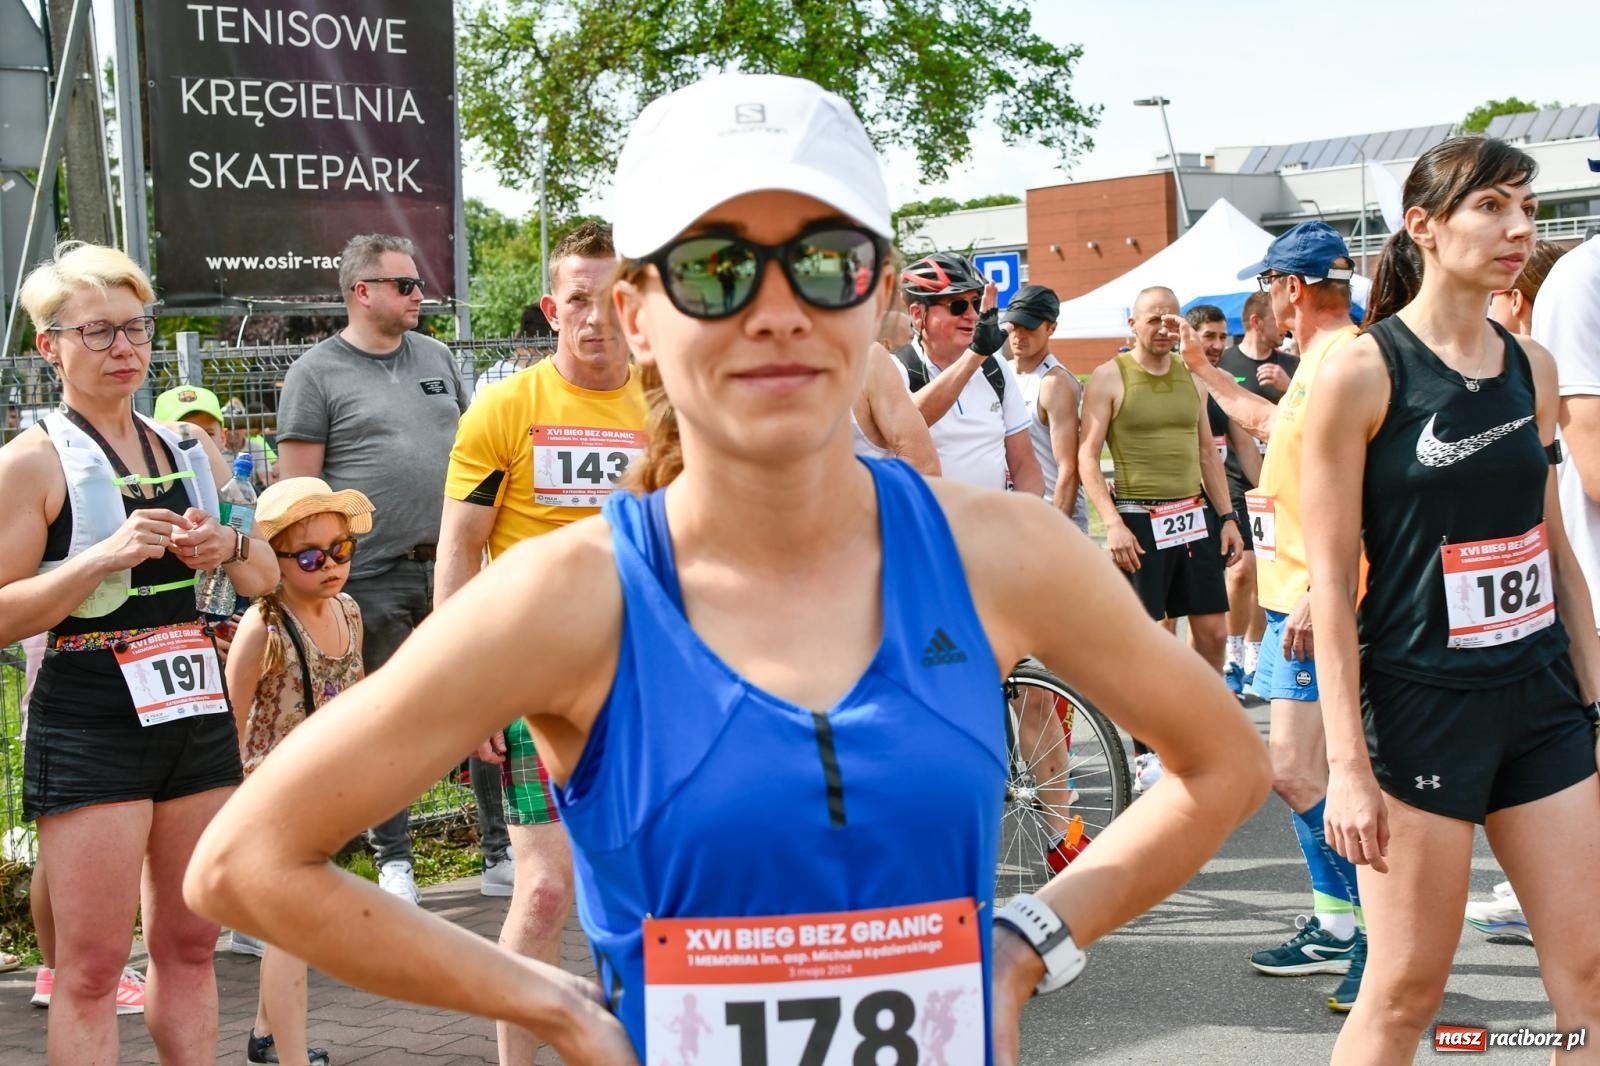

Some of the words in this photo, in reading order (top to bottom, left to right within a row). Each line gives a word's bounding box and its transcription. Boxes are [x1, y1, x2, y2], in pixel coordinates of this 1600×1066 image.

[187, 3, 408, 54] TENISOWE
[181, 77, 425, 127] KRĘGIELNIA
[188, 151, 423, 193] SKATEPARK
[983, 260, 1011, 293] P
[557, 451, 629, 484] 143
[1163, 512, 1194, 535] 237
[1476, 563, 1541, 618] 182
[152, 654, 205, 695] 197
[685, 928, 732, 951] XVI
[735, 926, 795, 950] BIEG
[799, 922, 847, 946] BEZ
[850, 912, 943, 943] GRANIC
[725, 990, 919, 1066] 178
